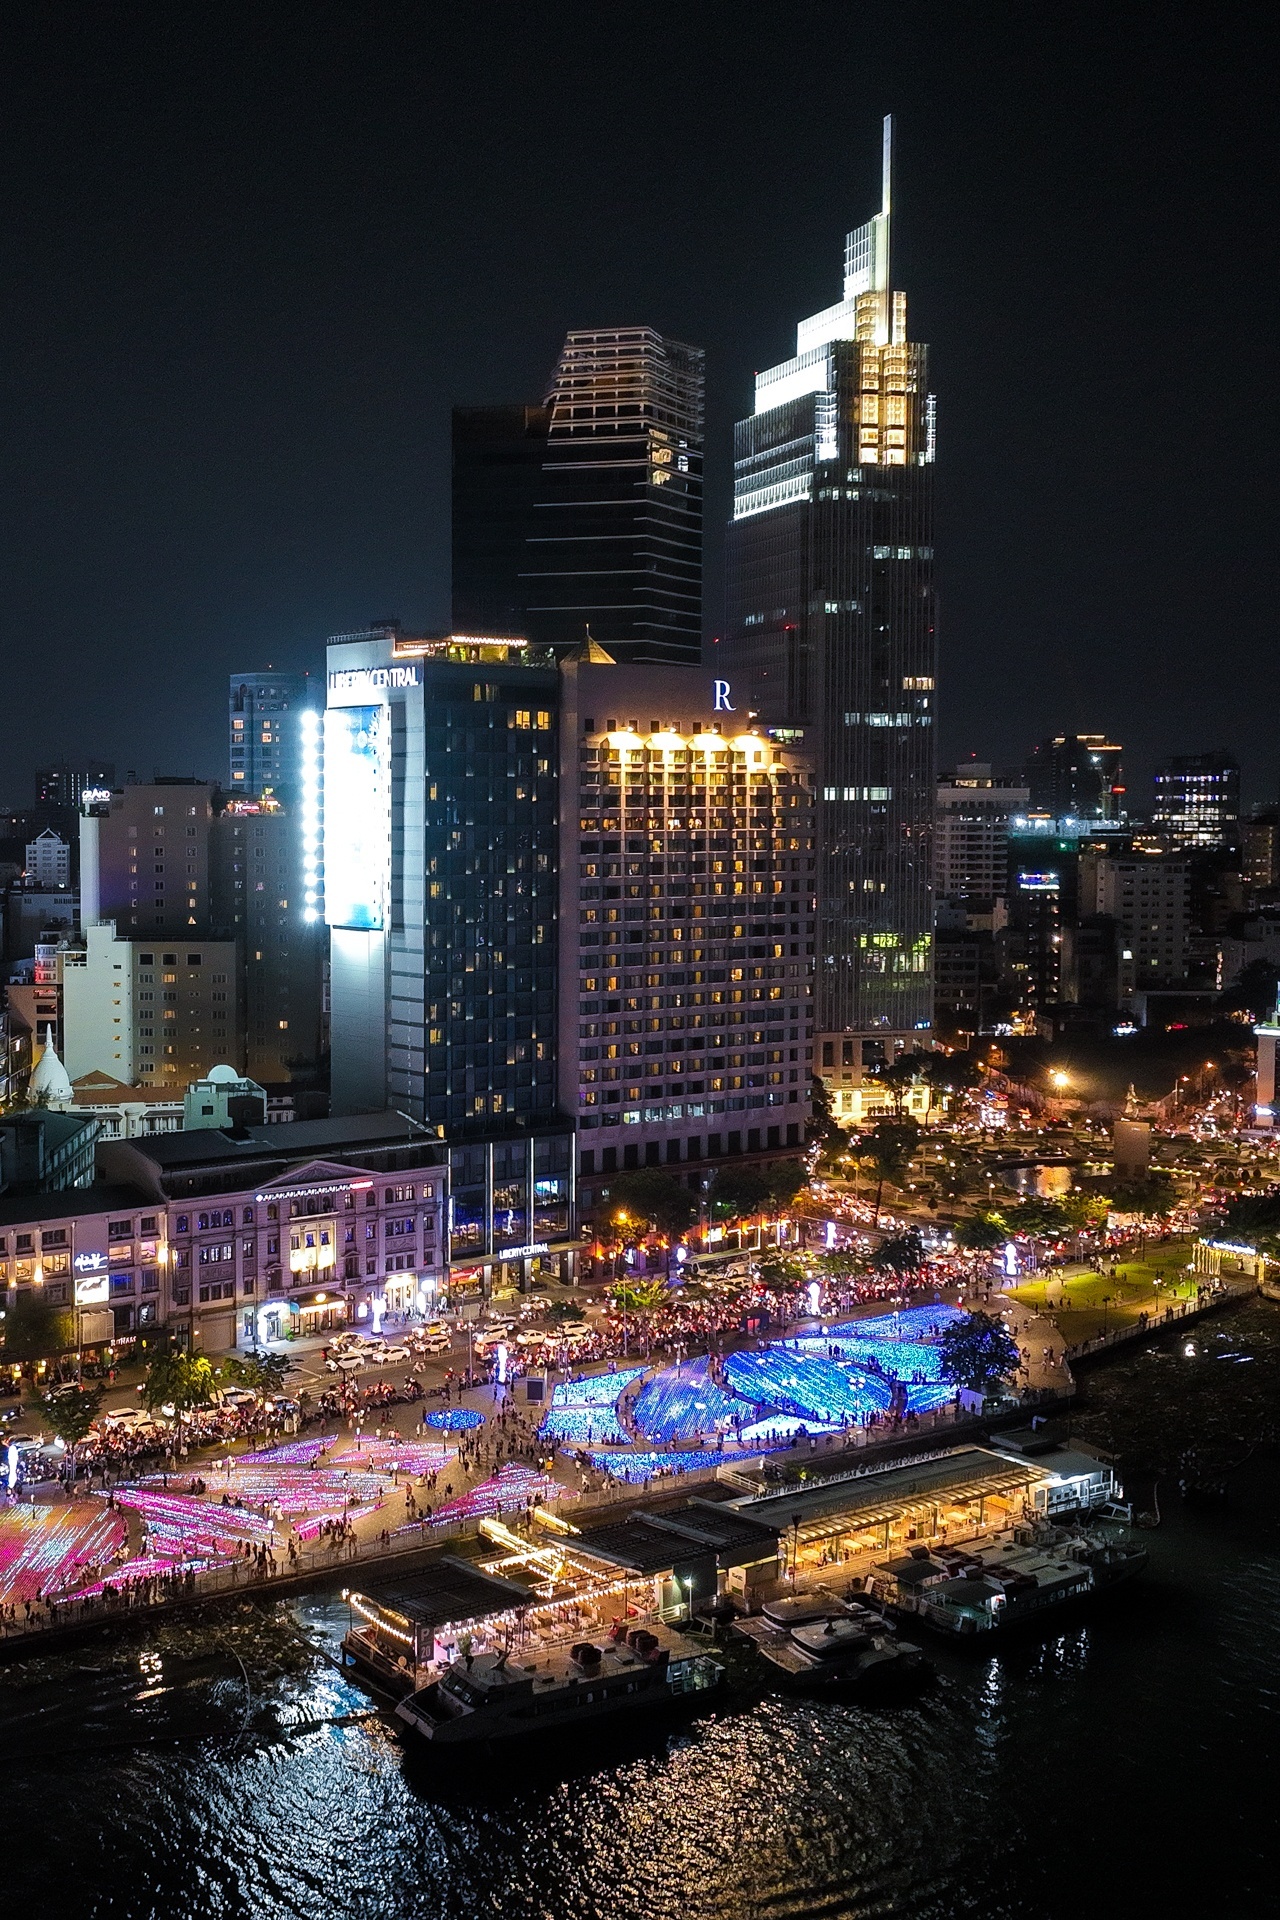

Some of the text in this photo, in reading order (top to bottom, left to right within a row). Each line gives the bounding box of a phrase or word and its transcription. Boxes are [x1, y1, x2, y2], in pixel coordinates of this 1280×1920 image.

[330, 667, 419, 689] LIBERTY CENTRAL
[713, 680, 737, 711] R
[82, 788, 110, 799] GRAND
[499, 1243, 548, 1259] LIBERTY CENTRAL
[421, 1645, 430, 1658] 20
